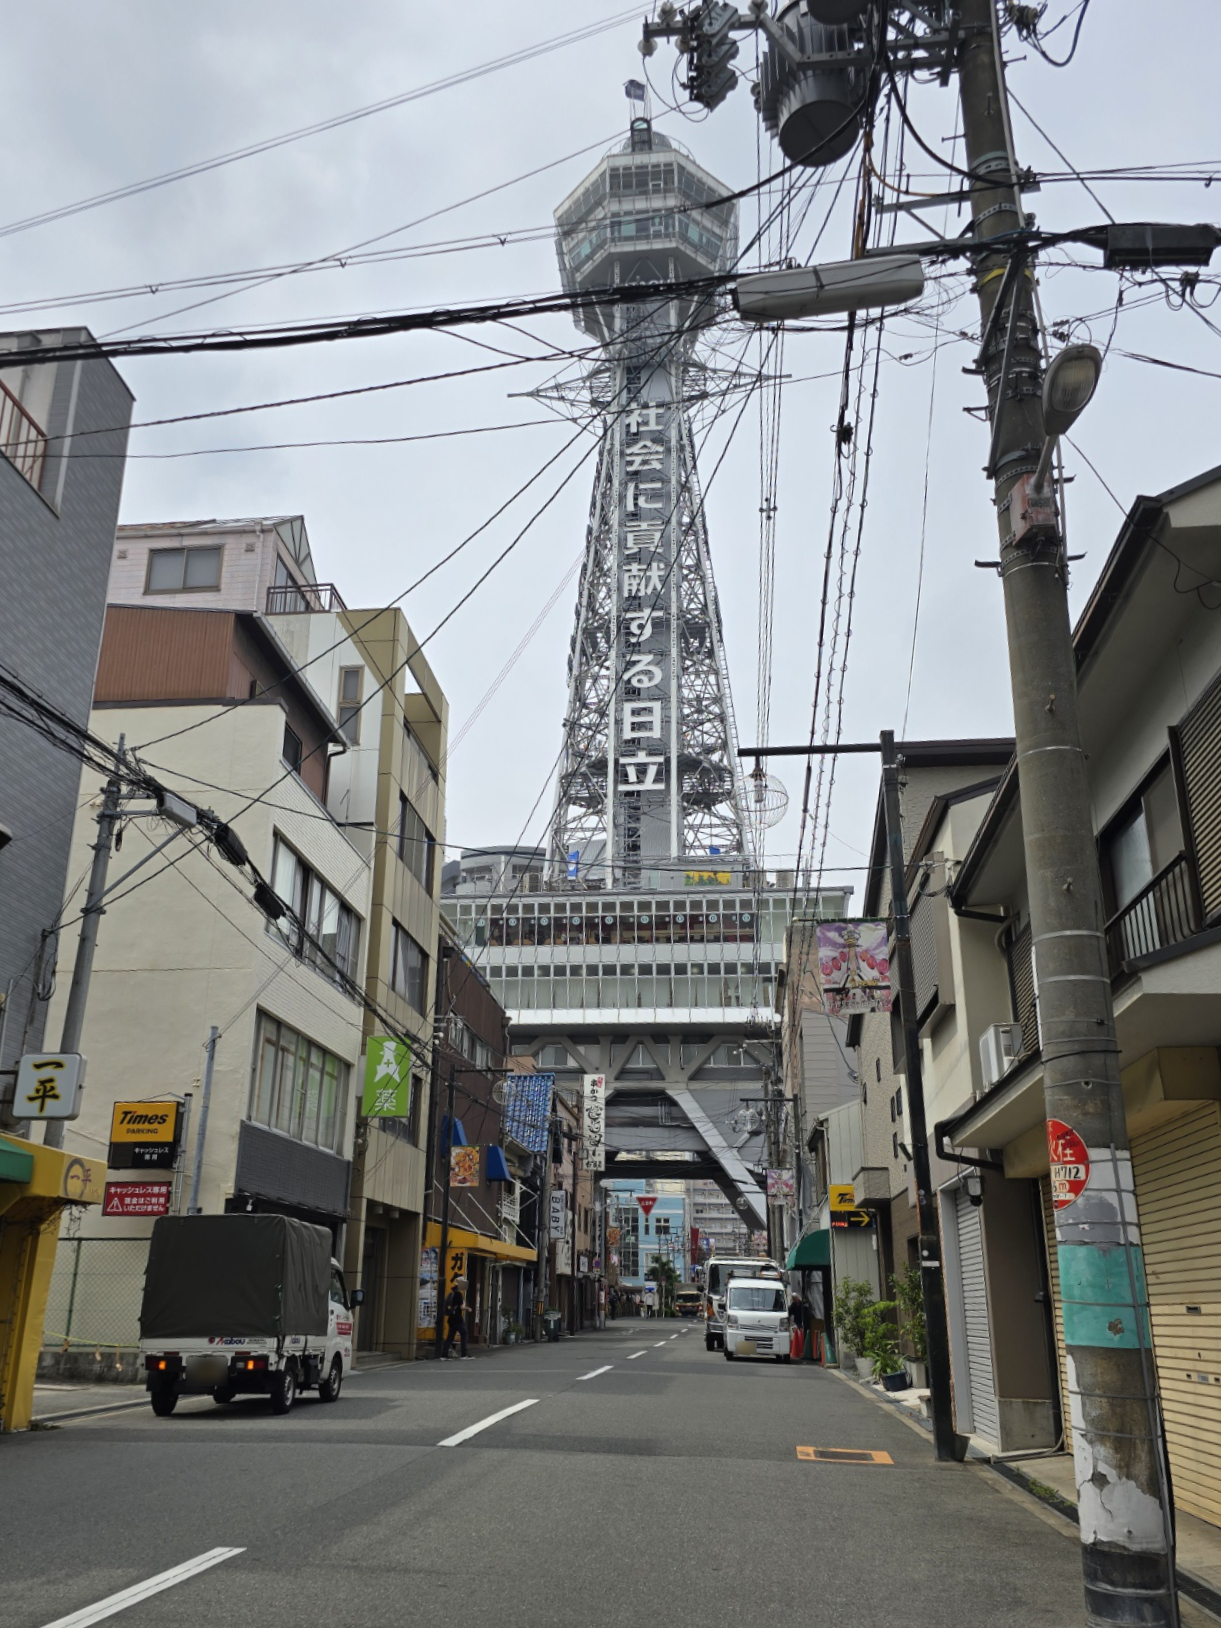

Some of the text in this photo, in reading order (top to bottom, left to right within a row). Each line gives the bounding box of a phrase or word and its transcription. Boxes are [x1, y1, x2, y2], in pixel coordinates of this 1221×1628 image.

[618, 402, 666, 791] 社会に貢献する日立
[27, 1060, 65, 1113] 一平
[374, 1089, 397, 1111] 薬
[119, 1110, 169, 1125] Times
[551, 1196, 560, 1233] BABY
